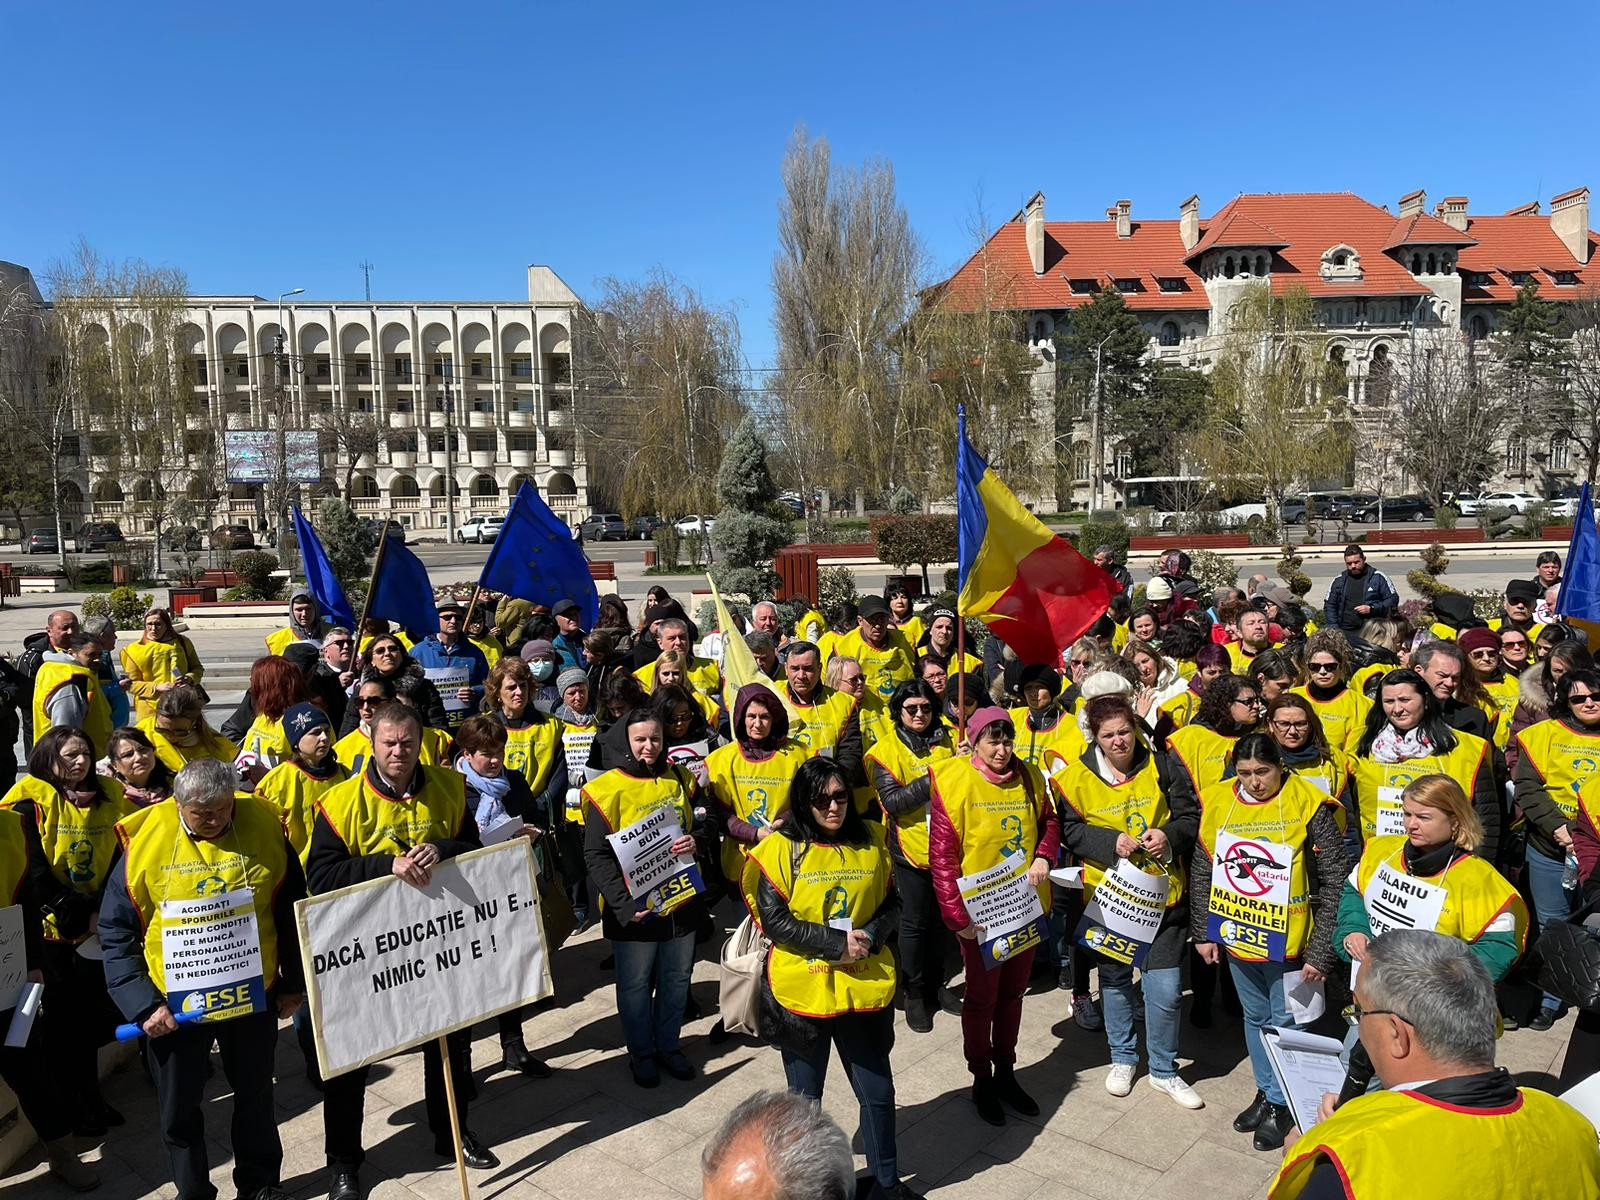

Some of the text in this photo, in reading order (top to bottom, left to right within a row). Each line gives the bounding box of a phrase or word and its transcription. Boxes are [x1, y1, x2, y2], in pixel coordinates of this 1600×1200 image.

[621, 812, 666, 844] SALARIU
[639, 829, 661, 848] BUN
[629, 845, 675, 879] PROFESO
[636, 855, 680, 888] MOTIVAT
[660, 873, 692, 900] FSE
[977, 871, 1017, 893] SPORURILE
[1110, 872, 1164, 901] RESPECTAȚI
[1378, 869, 1429, 900] SALARIU
[181, 900, 231, 914] ACORDAȚI
[966, 889, 996, 905] PENTRU
[975, 892, 1030, 917] PERSONALULUI
[1007, 894, 1038, 914] AUXILIAR
[1091, 894, 1109, 909] DIN
[1096, 887, 1162, 919] SALARIAȚILOR
[1104, 880, 1161, 910] DREPTURILE
[1212, 887, 1284, 918] MAJORAȚI
[1381, 888, 1408, 910] BUN
[165, 916, 250, 937] PENTRU CONDIȚII
[181, 909, 236, 925] SPORURILE
[1210, 900, 1285, 930] SALARIILE!
[183, 931, 235, 947] DE MUNCĂ
[313, 936, 366, 976] DACĂ
[473, 899, 498, 924] NU
[1007, 923, 1039, 949] FSE
[1103, 932, 1139, 957] FSE
[1235, 924, 1269, 948] FSE
[165, 946, 260, 970] DIDACTIC AUXILIAR
[172, 939, 248, 959] PERSONALULUI
[435, 946, 461, 972] NU
[470, 939, 483, 960] E
[174, 960, 250, 982] ȘI NEDIDACTIC!
[205, 983, 251, 1009] FSE
